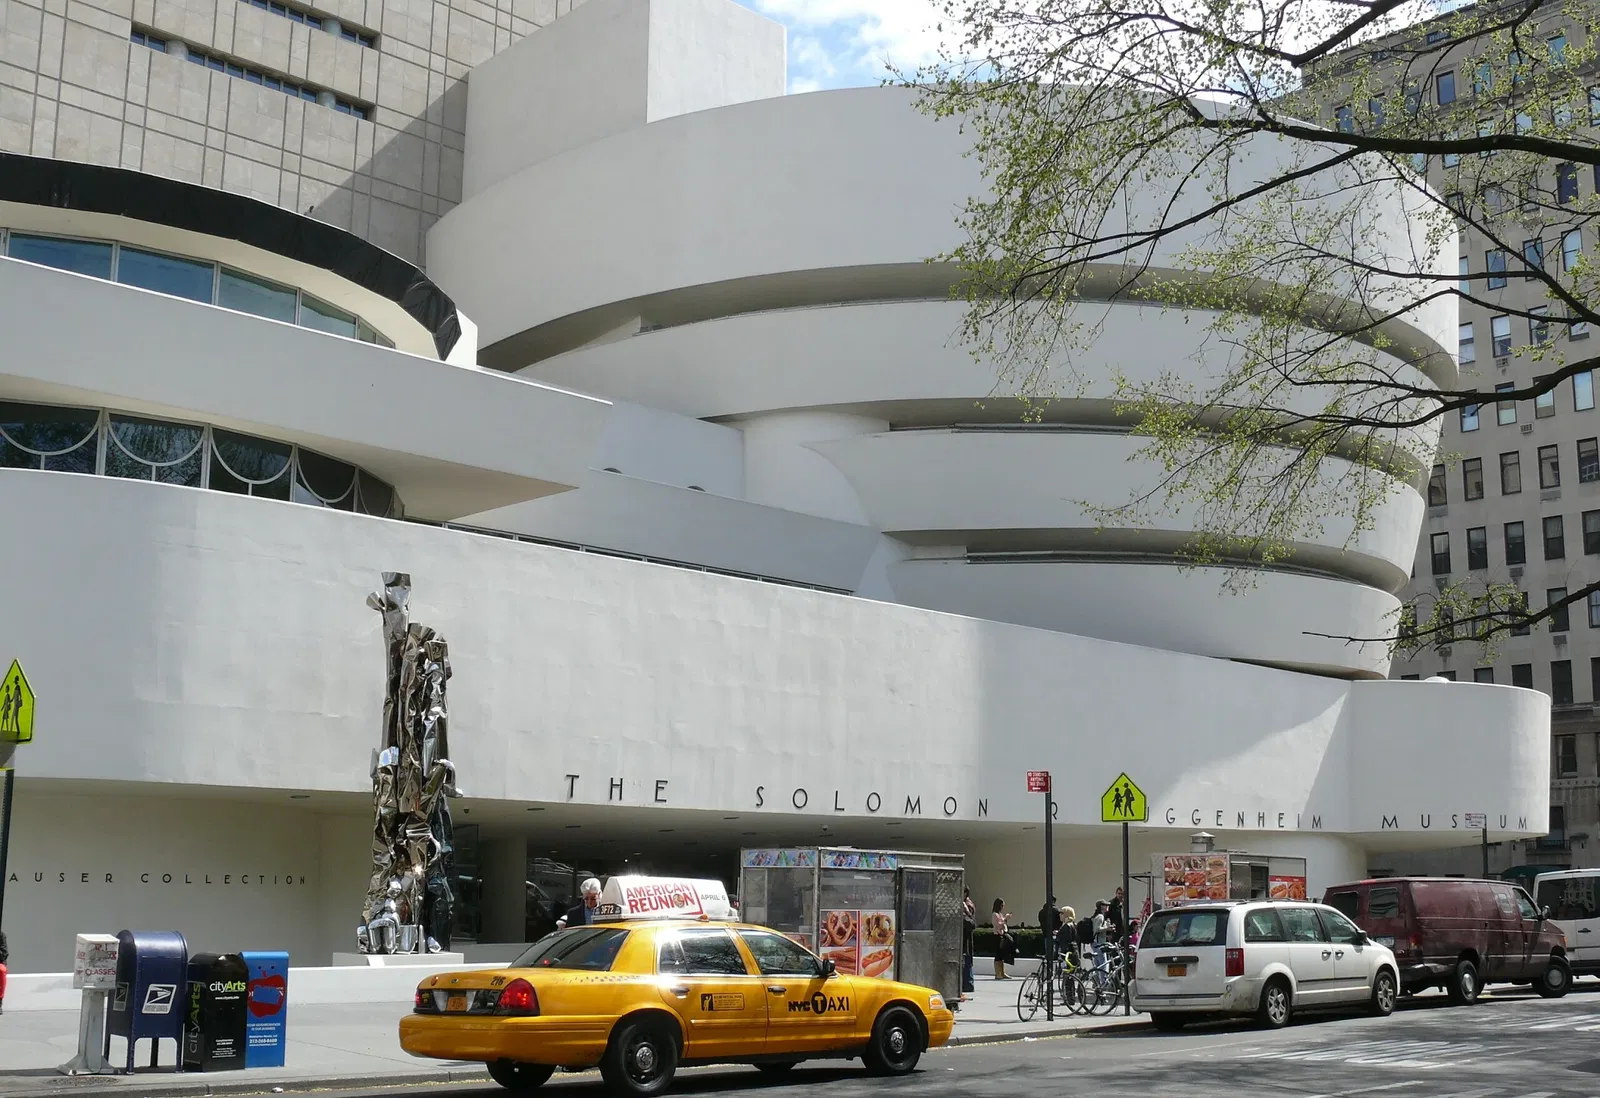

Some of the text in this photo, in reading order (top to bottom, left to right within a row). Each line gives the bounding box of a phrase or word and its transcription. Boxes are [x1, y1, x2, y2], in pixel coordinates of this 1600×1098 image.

[565, 774, 668, 803] THE
[755, 786, 988, 818] SOLOMON
[1144, 807, 1322, 829] GGENHEIM
[1381, 814, 1528, 830] MUSUM
[8, 872, 306, 885] AUSER COLLECTION
[626, 882, 691, 900] AMERICAN
[209, 980, 246, 993] cityArts
[788, 1001, 811, 1012] NYC
[188, 983, 201, 1054] cityArts
